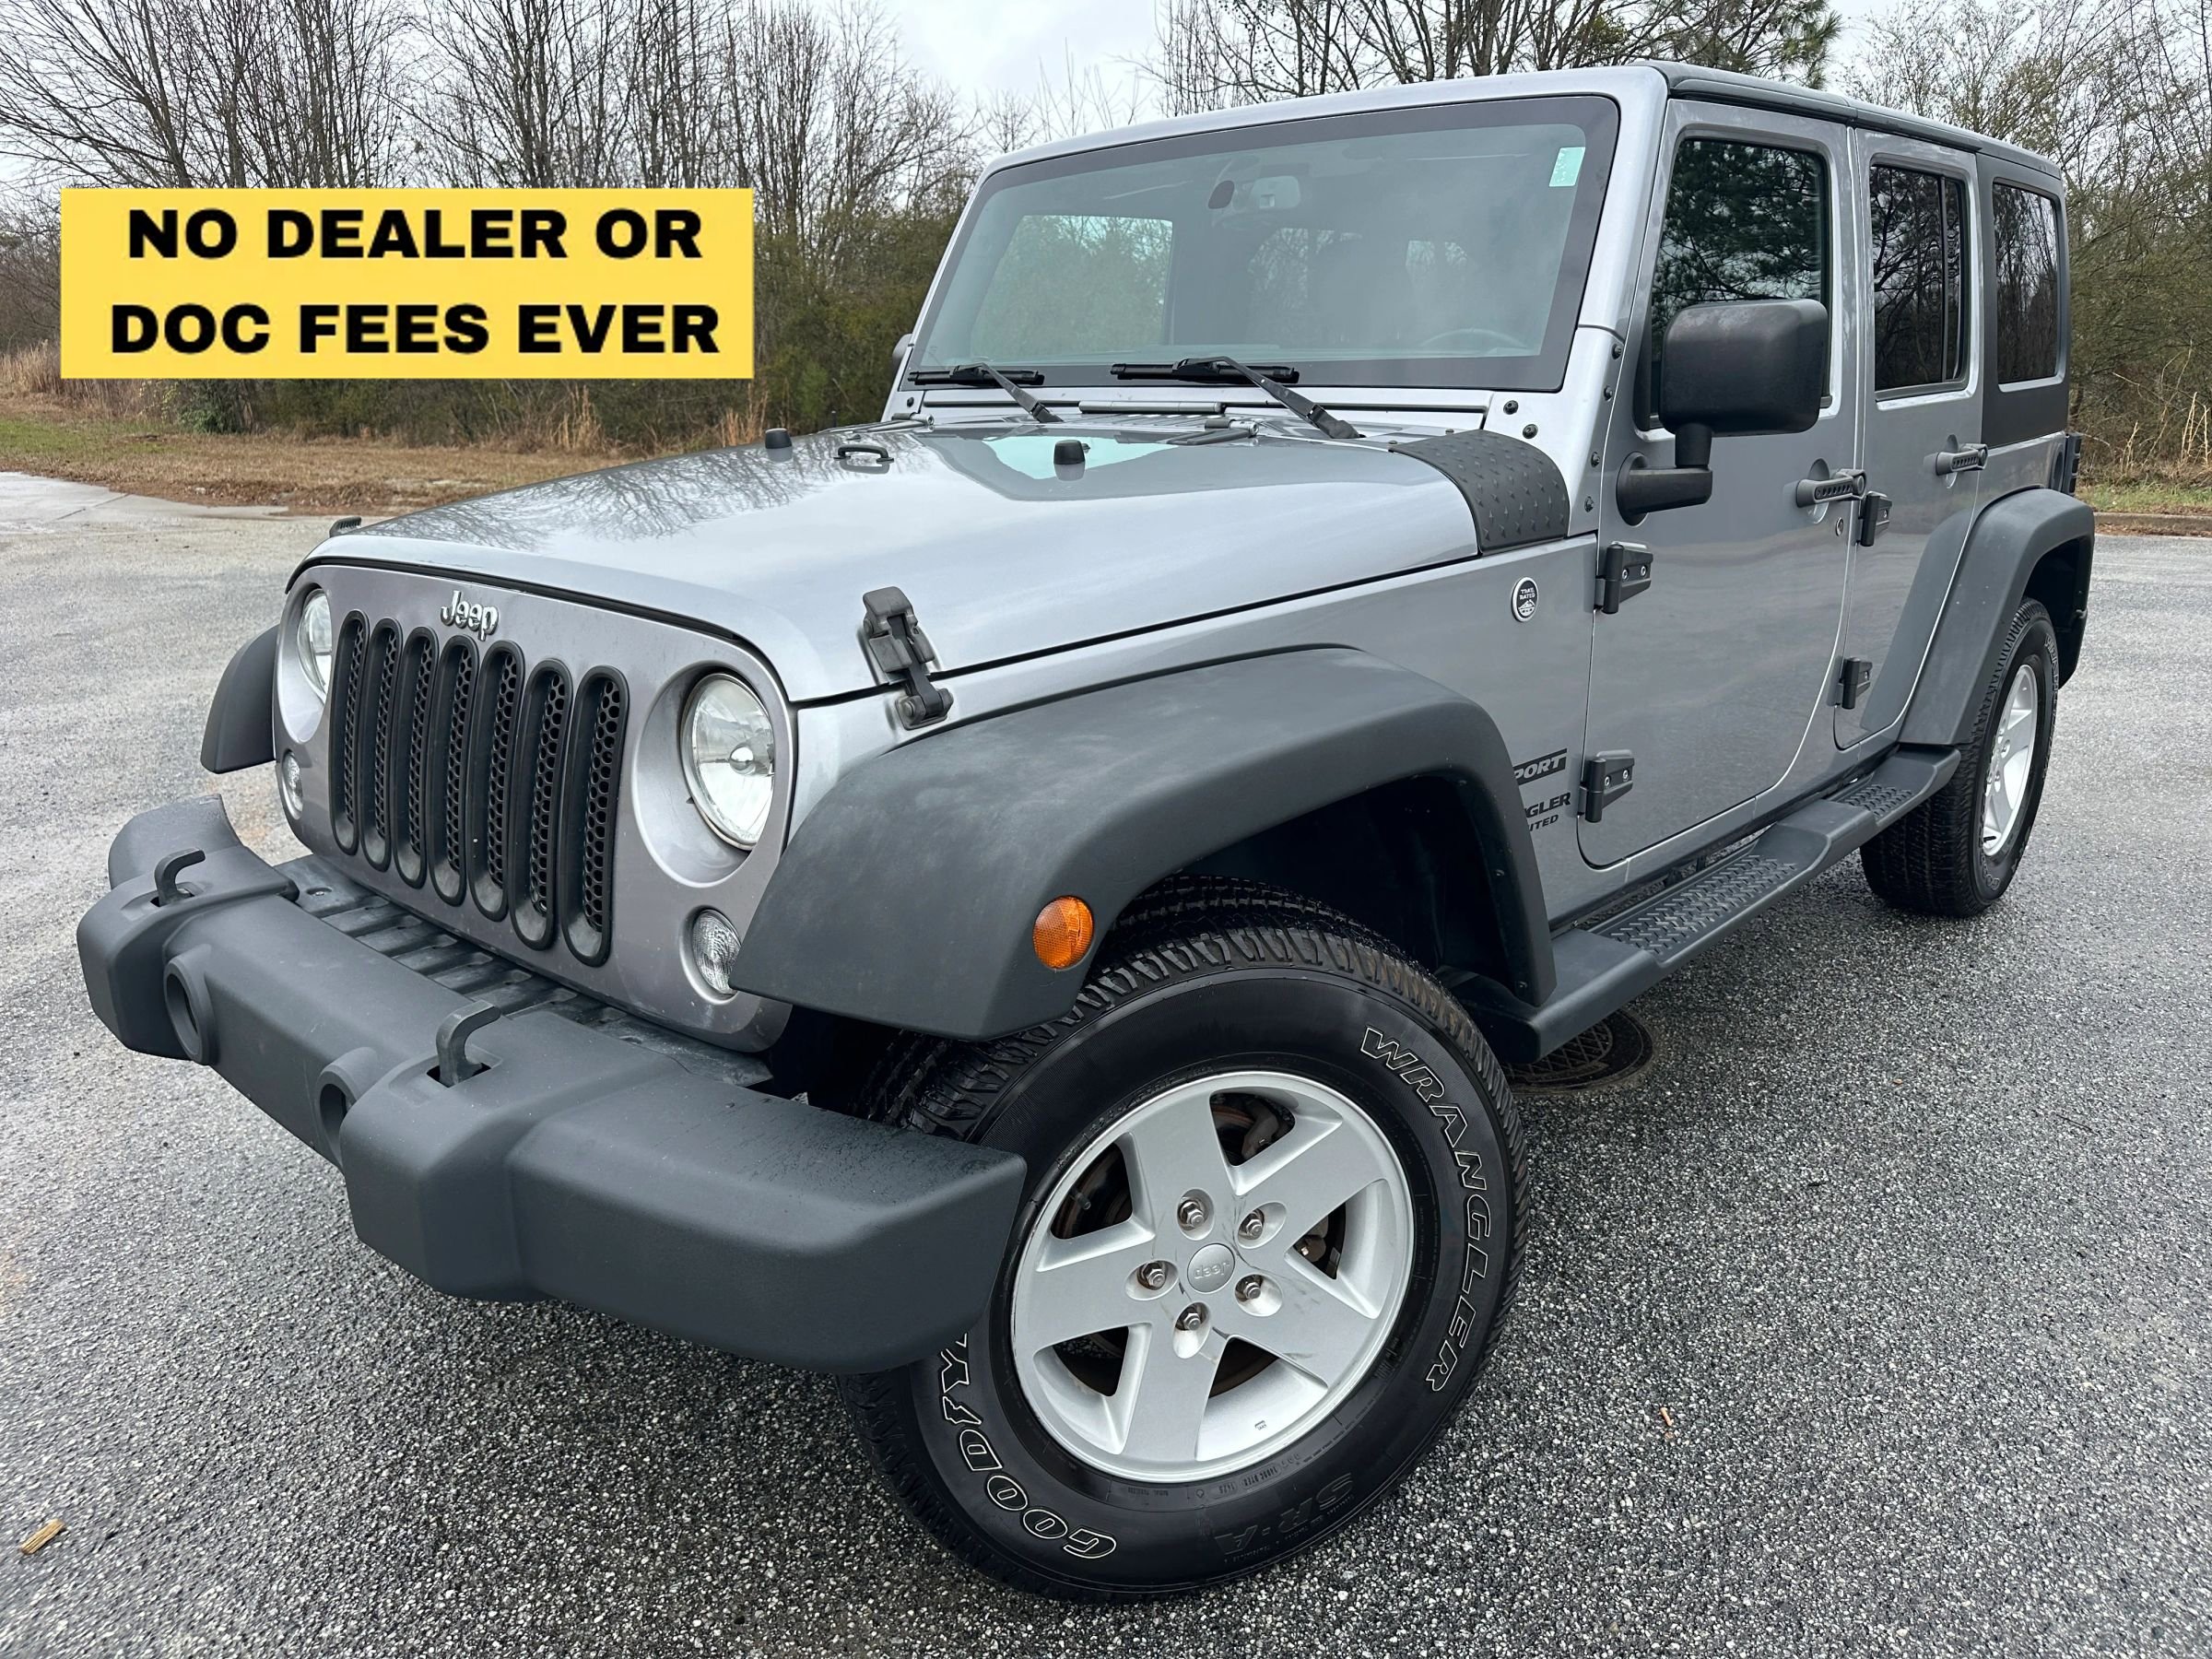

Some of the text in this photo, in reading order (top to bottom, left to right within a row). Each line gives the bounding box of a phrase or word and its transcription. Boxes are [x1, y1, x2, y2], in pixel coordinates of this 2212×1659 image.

[441, 590, 499, 641] Jeep
[1524, 792, 1571, 818] GLER
[1360, 1027, 1491, 1392] WRANGLER
[940, 1333, 1117, 1559] GOODY
